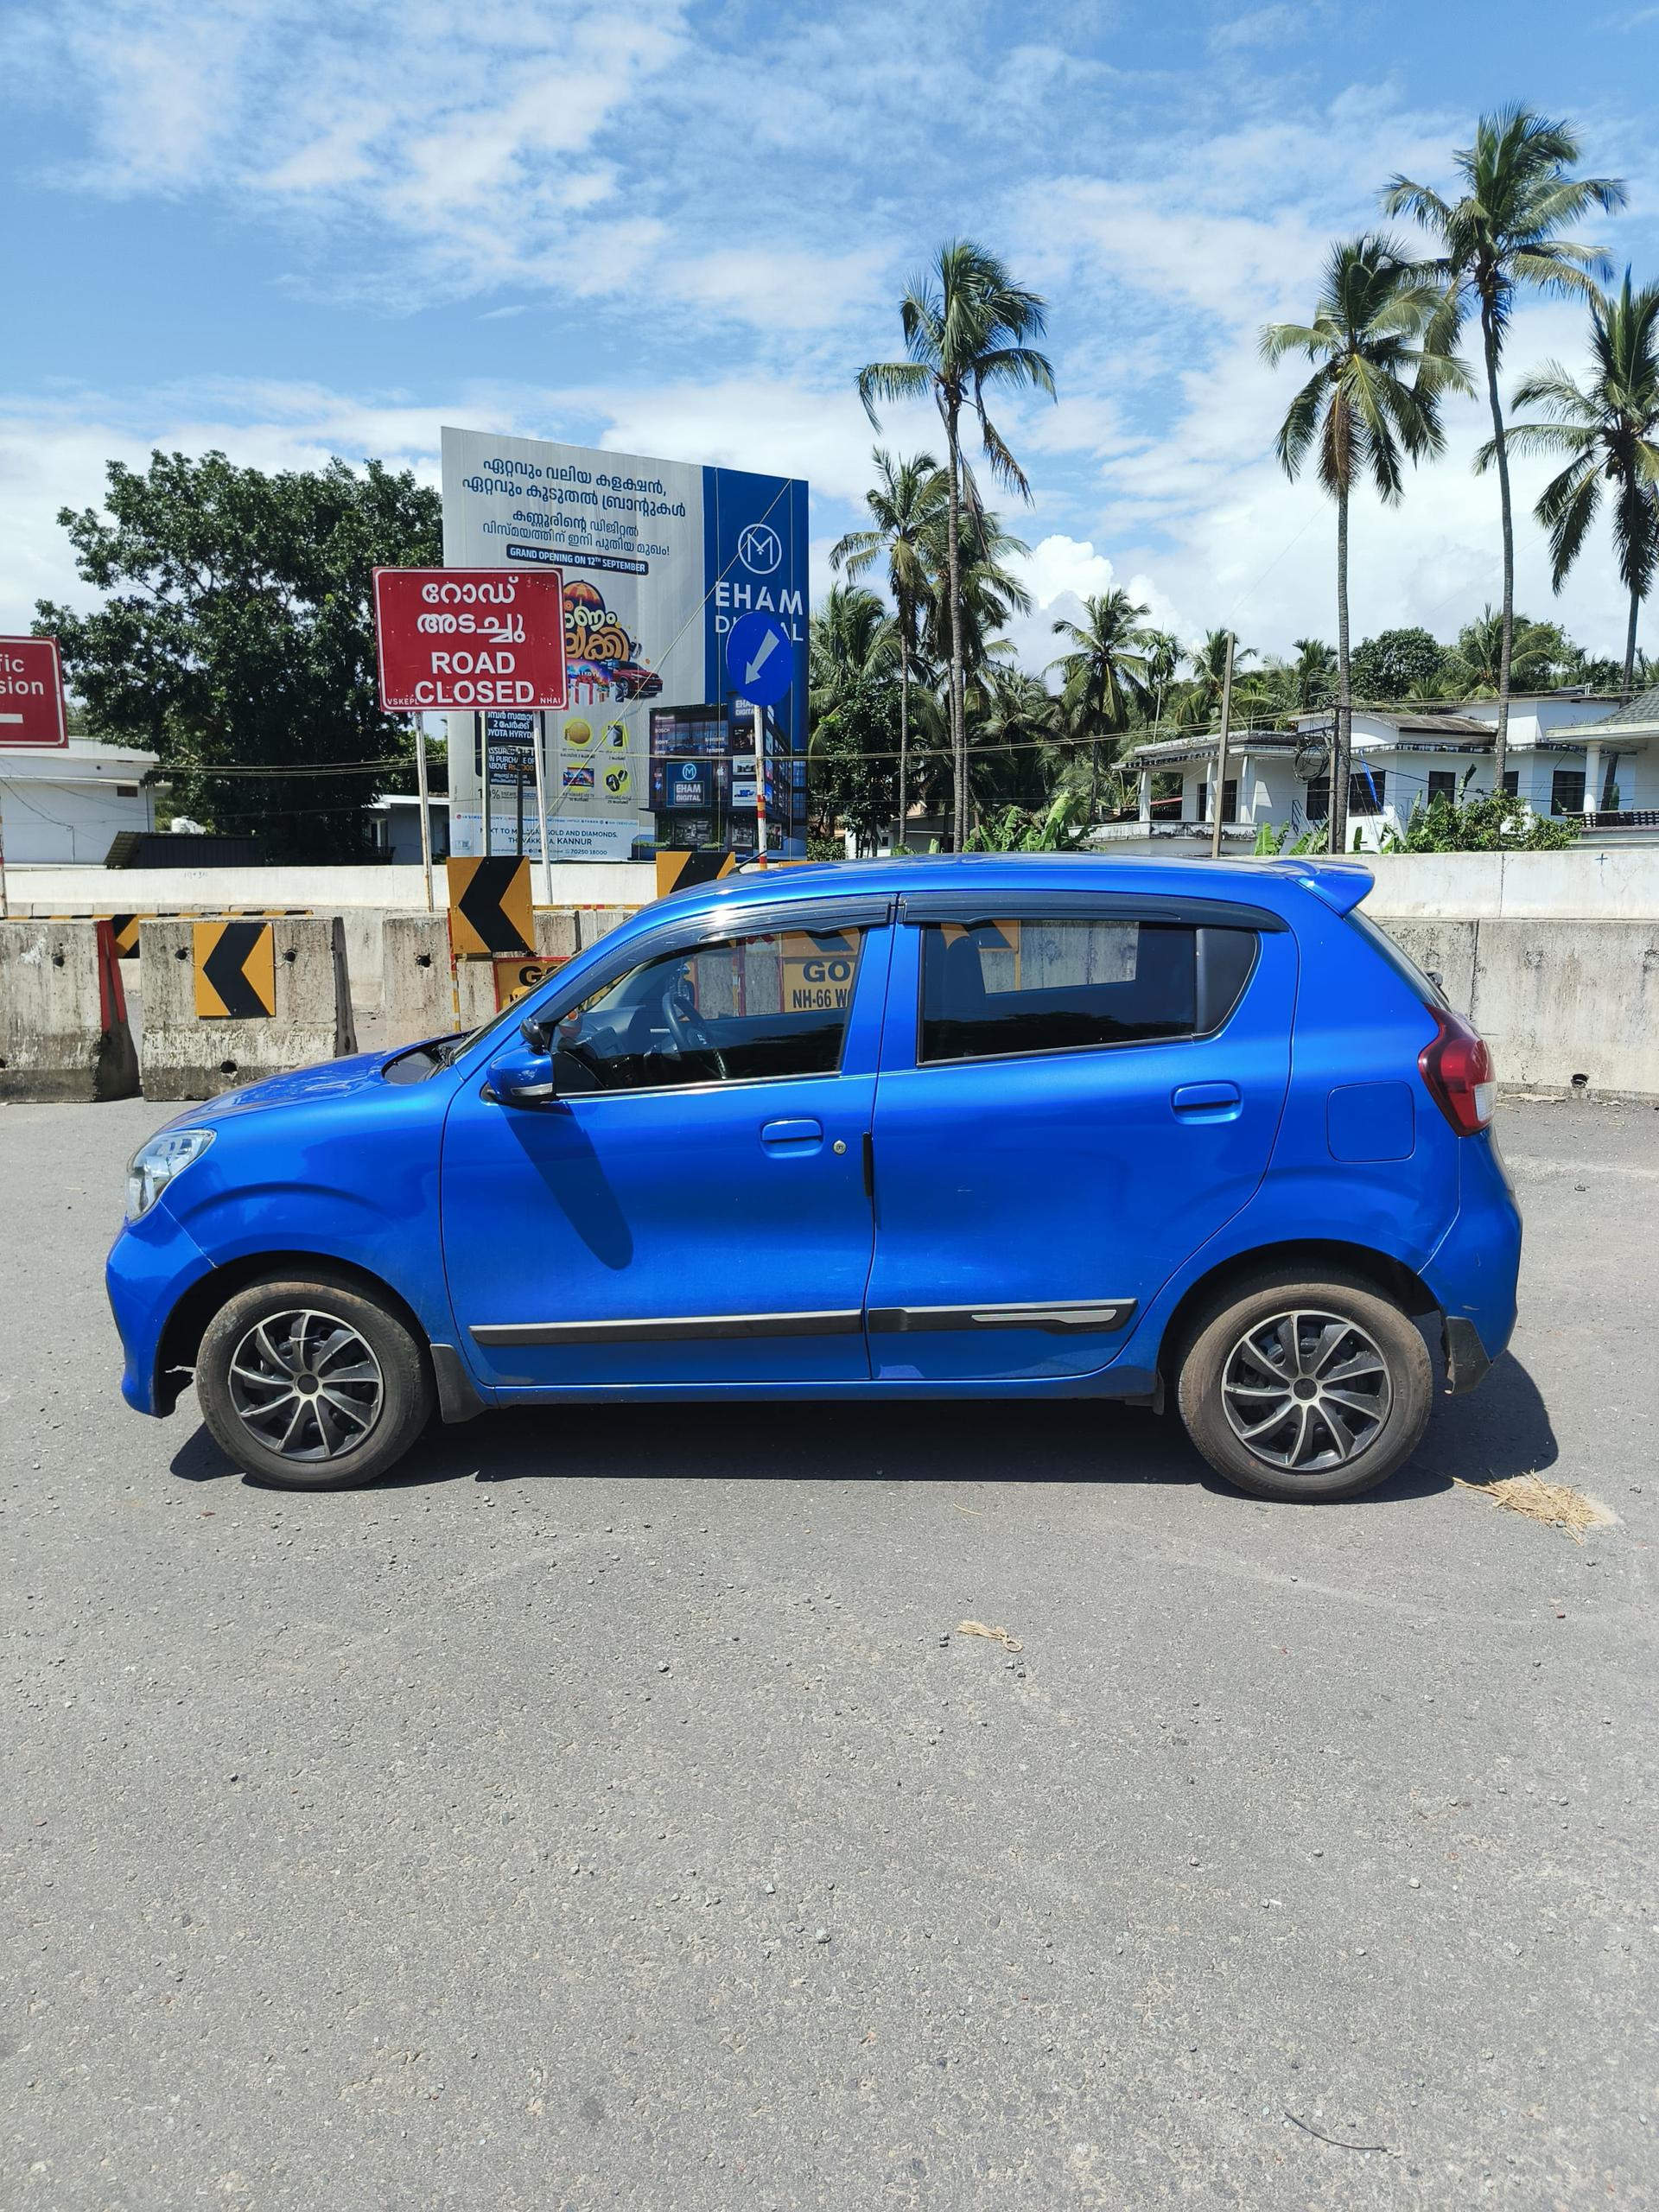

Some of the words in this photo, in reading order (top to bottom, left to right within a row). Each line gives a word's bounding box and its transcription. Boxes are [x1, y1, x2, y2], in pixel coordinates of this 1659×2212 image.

[483, 458, 543, 480] ഏറ്റവും
[546, 466, 592, 485] വലിയ
[462, 476, 523, 497] ഏറ്റവും
[526, 485, 599, 505] കൂടുതൽ
[590, 518, 639, 537] ഡിജിറ്റൽ
[568, 532, 593, 546] ഇനി
[595, 537, 635, 551] പുതിയ
[637, 543, 670, 556] മുഖം!
[510, 547, 537, 559] GRAND
[538, 550, 573, 563] OPENING
[575, 556, 586, 565] ON
[601, 558, 646, 573] SEPTEMBER
[422, 575, 519, 604] റോഡ്
[715, 581, 804, 615] EHAM
[416, 613, 526, 643] അടച്ചു
[430, 652, 516, 675] ROAD
[415, 680, 535, 704] CLOSED
[735, 699, 754, 709] EHA
[478, 788, 500, 800] 1%
[676, 784, 701, 793] EHAM
[803, 960, 851, 982] GO
[792, 988, 832, 1008] NH-66
